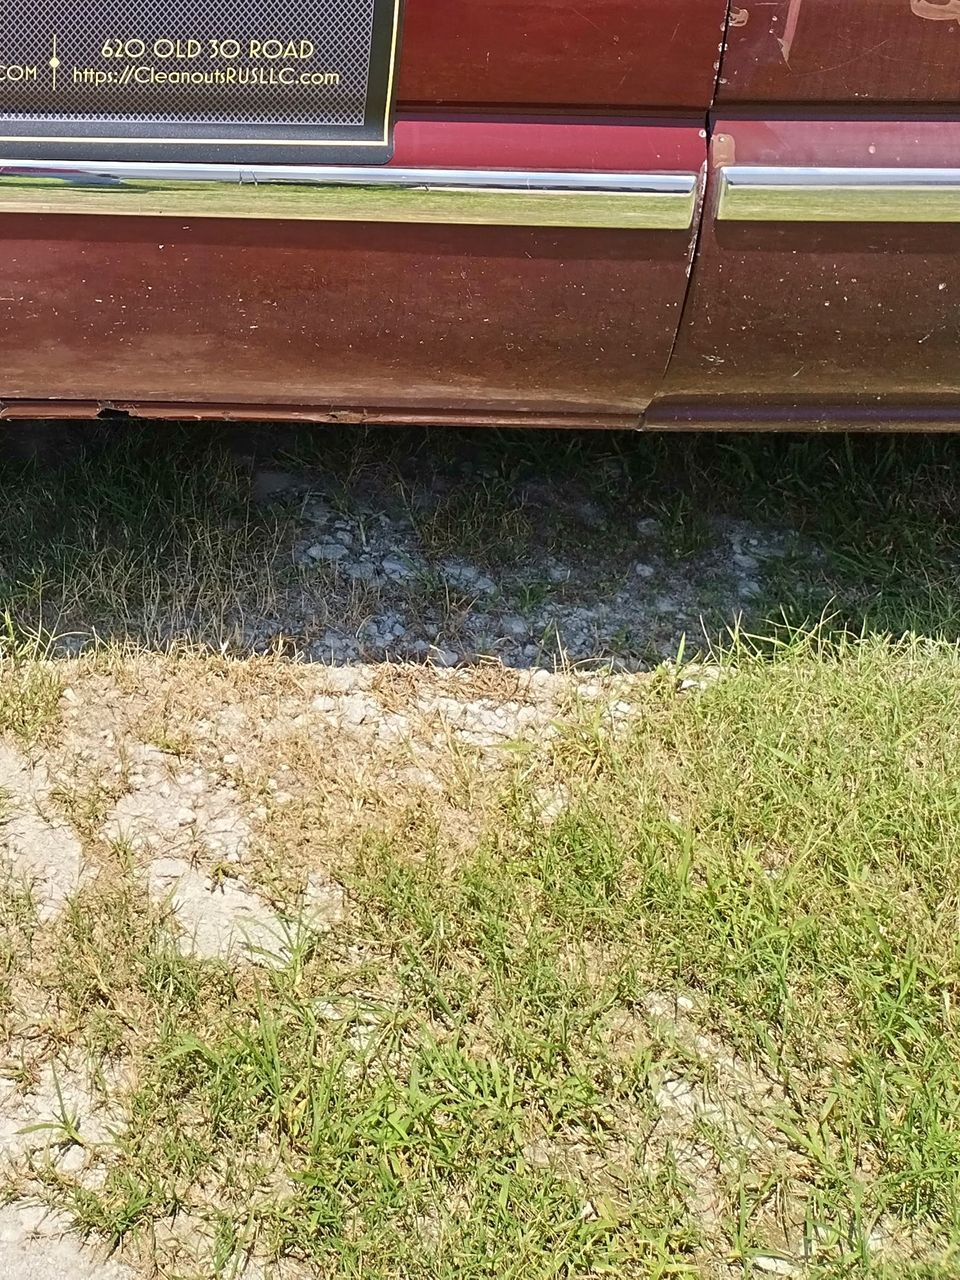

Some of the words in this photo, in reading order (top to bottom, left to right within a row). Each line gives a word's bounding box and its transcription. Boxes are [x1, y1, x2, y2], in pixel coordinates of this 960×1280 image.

[101, 38, 146, 58] 620
[153, 38, 201, 59] OLD
[209, 39, 242, 59] 30
[249, 39, 314, 59] ROAD
[73, 65, 340, 86] https://CleanoutsRUSLLC.com
